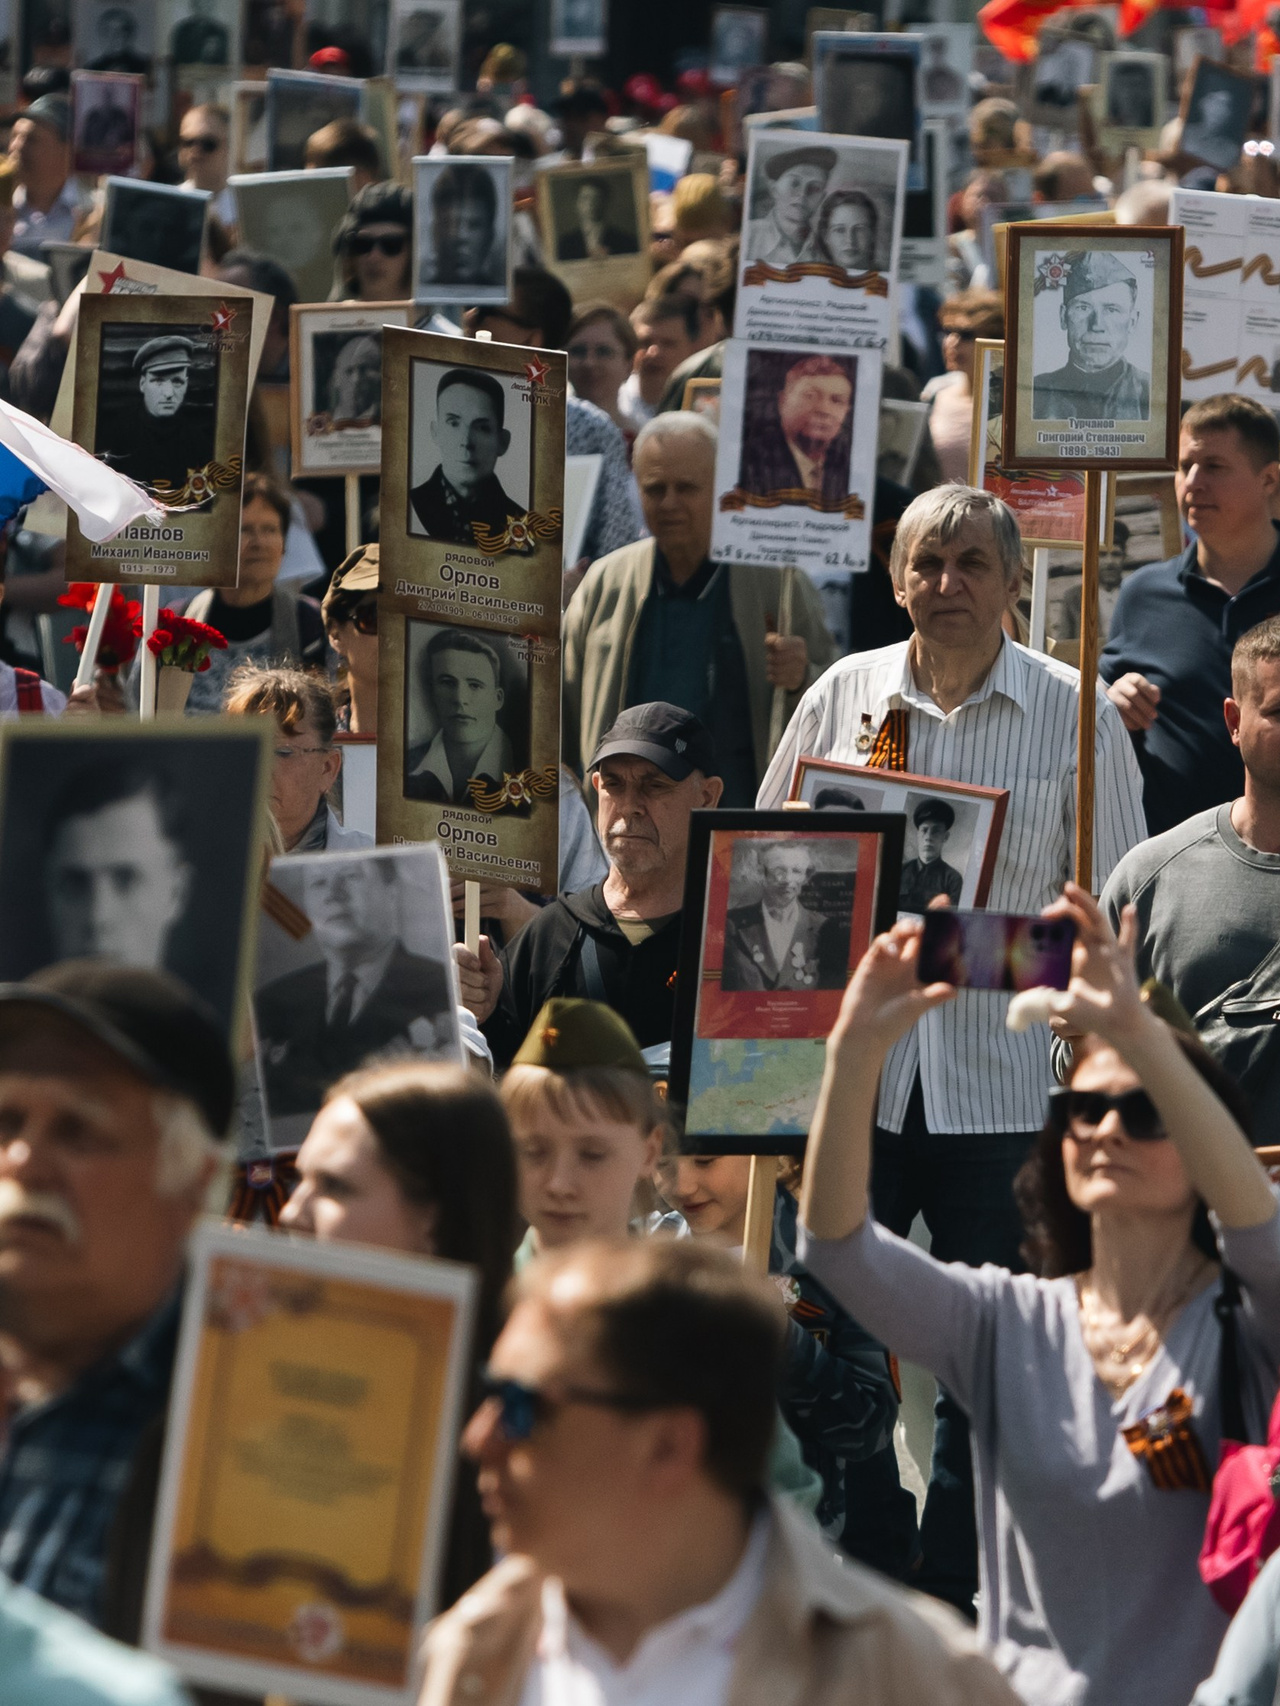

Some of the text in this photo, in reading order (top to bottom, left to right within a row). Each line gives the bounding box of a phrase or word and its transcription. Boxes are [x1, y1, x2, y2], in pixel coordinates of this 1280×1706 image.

[1069, 418, 1115, 429] Турчанов
[1038, 432, 1145, 443] Григорий Степанович
[91, 545, 209, 560] Михаил Иванович
[121, 564, 144, 573] 1913
[153, 565, 176, 574] 1973
[439, 564, 500, 590] Орлов
[396, 579, 544, 615] Дмитрий Васильевич
[437, 821, 498, 847] Орлов
[456, 846, 541, 872] Васильевич
